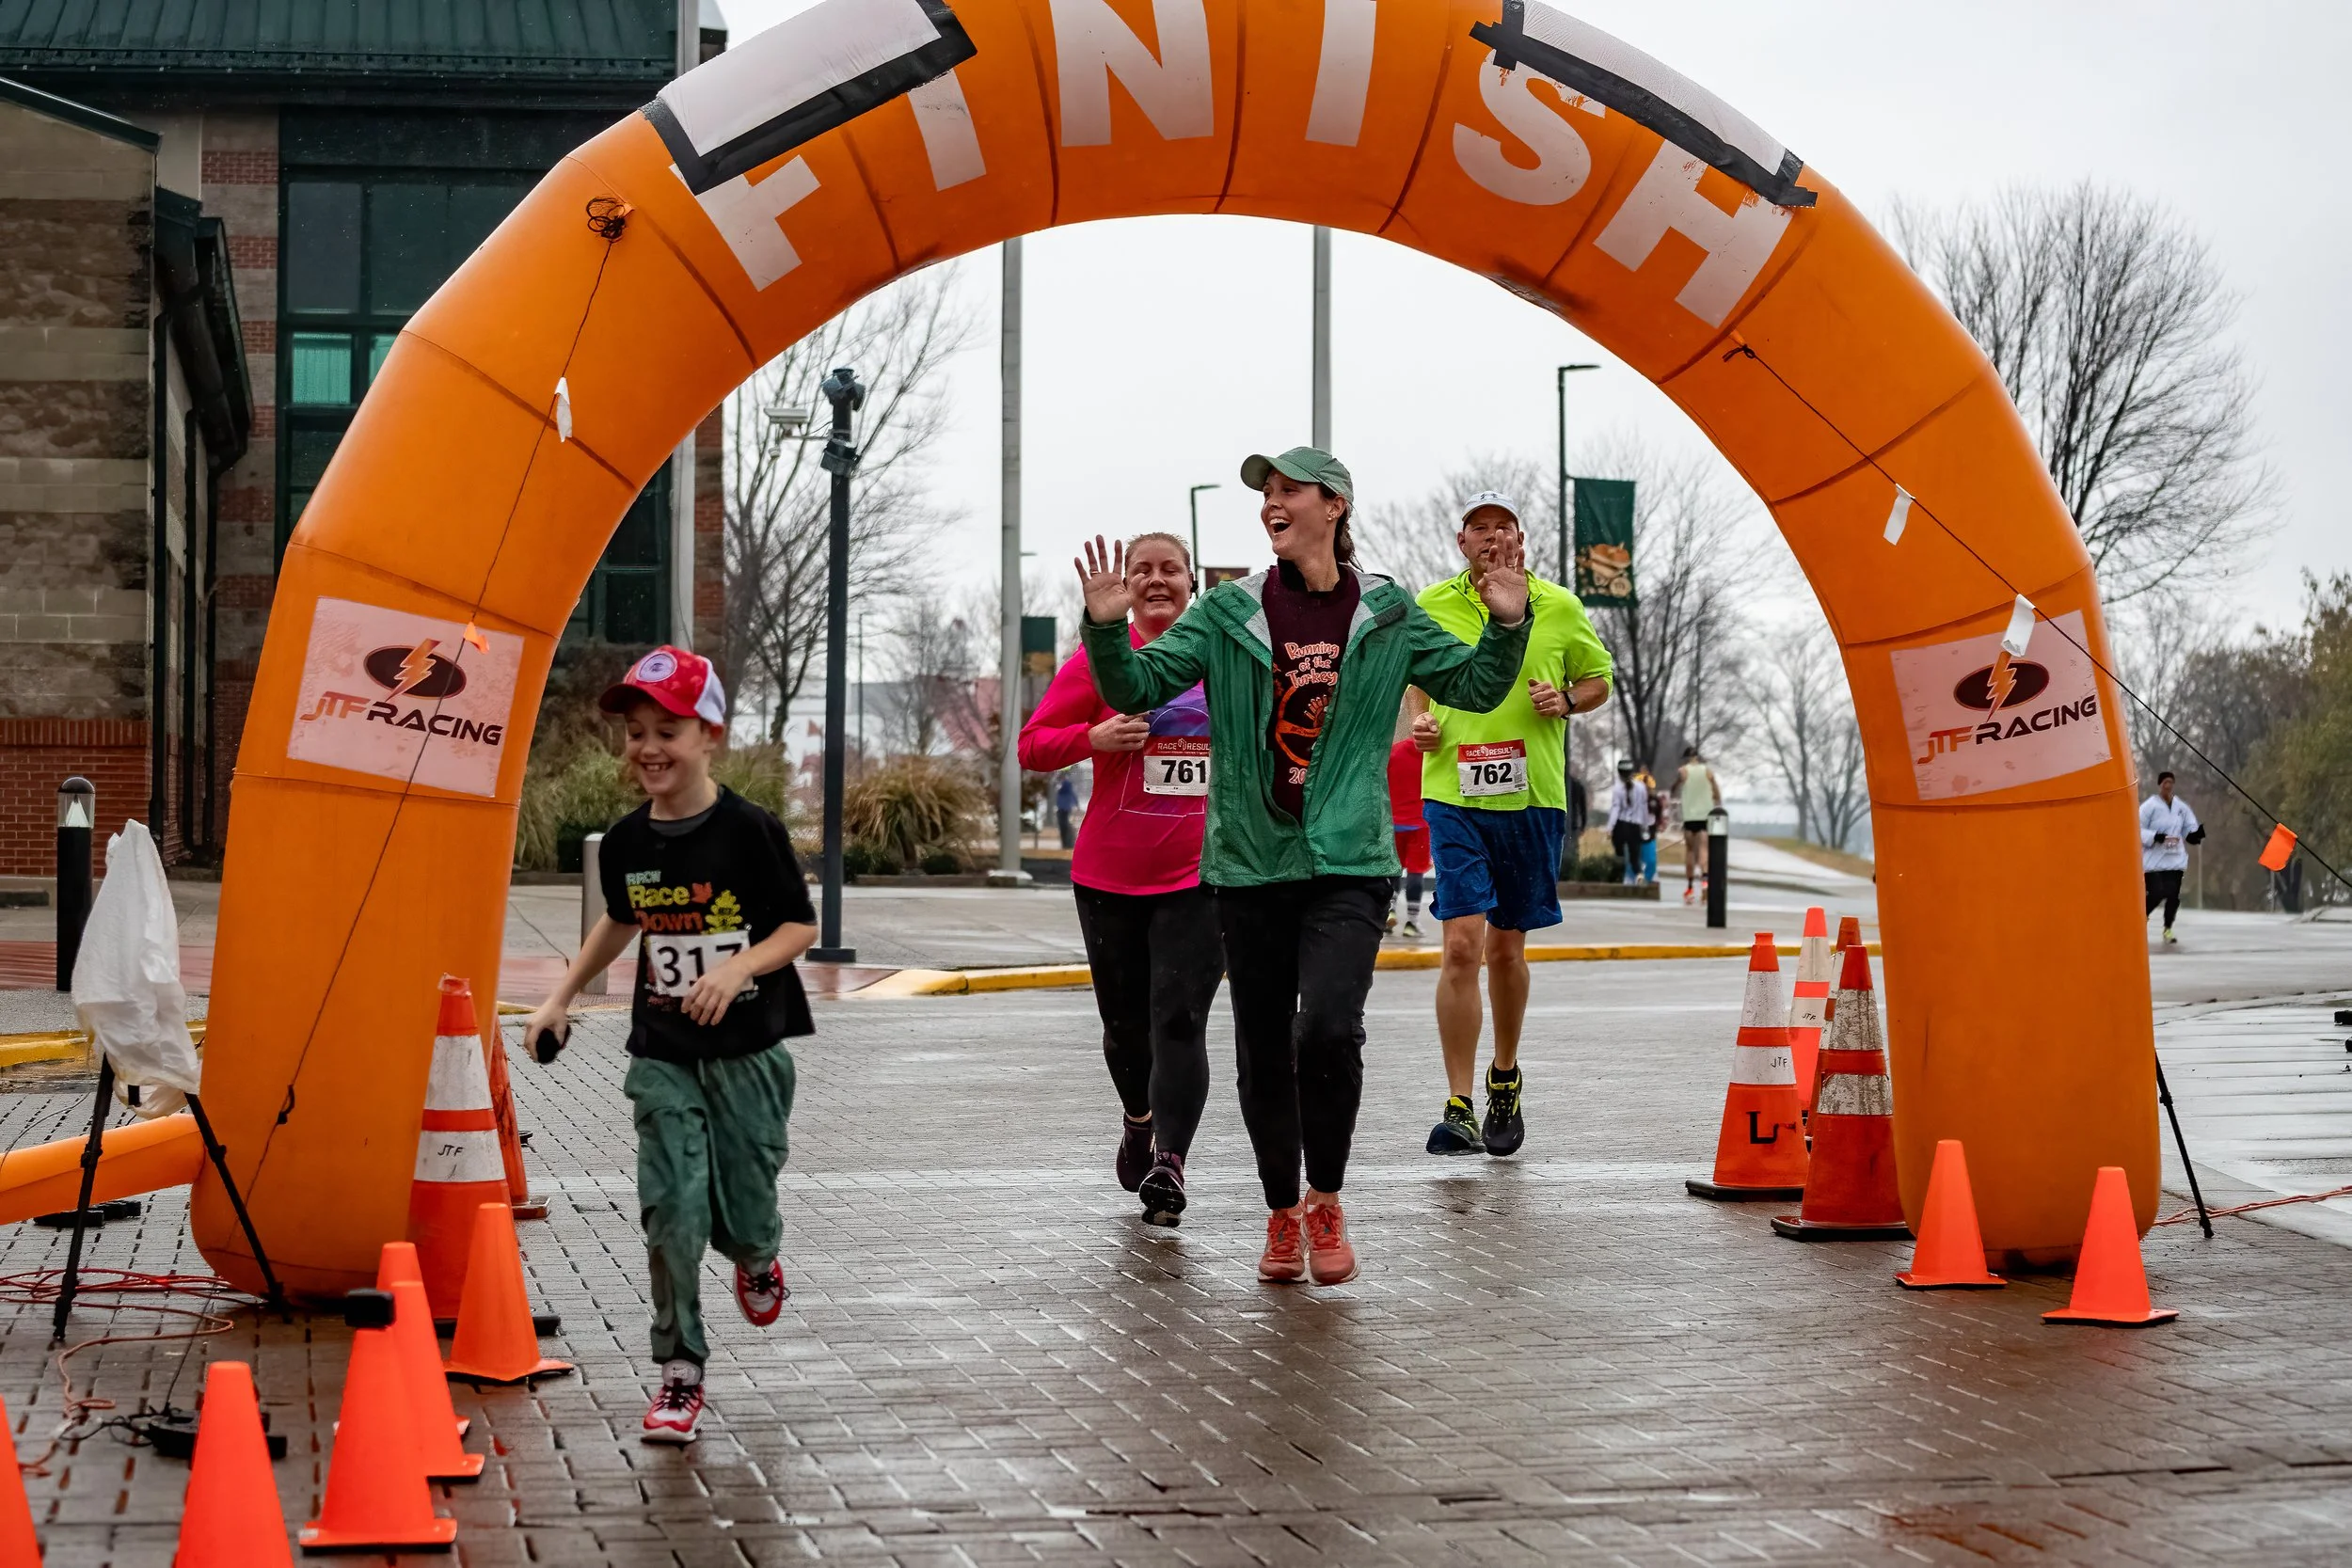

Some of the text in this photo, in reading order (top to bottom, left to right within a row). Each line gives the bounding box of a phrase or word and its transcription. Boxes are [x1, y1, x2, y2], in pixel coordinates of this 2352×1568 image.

[1284, 641, 1340, 659] Running
[1299, 657, 1311, 672] of
[1285, 669, 1338, 688] Turkey
[1158, 742, 1211, 751] RACE RESUL
[1489, 746, 1514, 756] RESULT
[1161, 760, 1206, 784] 761
[1470, 762, 1513, 785] 762
[628, 885, 691, 909] Race
[1771, 1056, 1788, 1068] JTF
[437, 1144, 465, 1157] JTF
